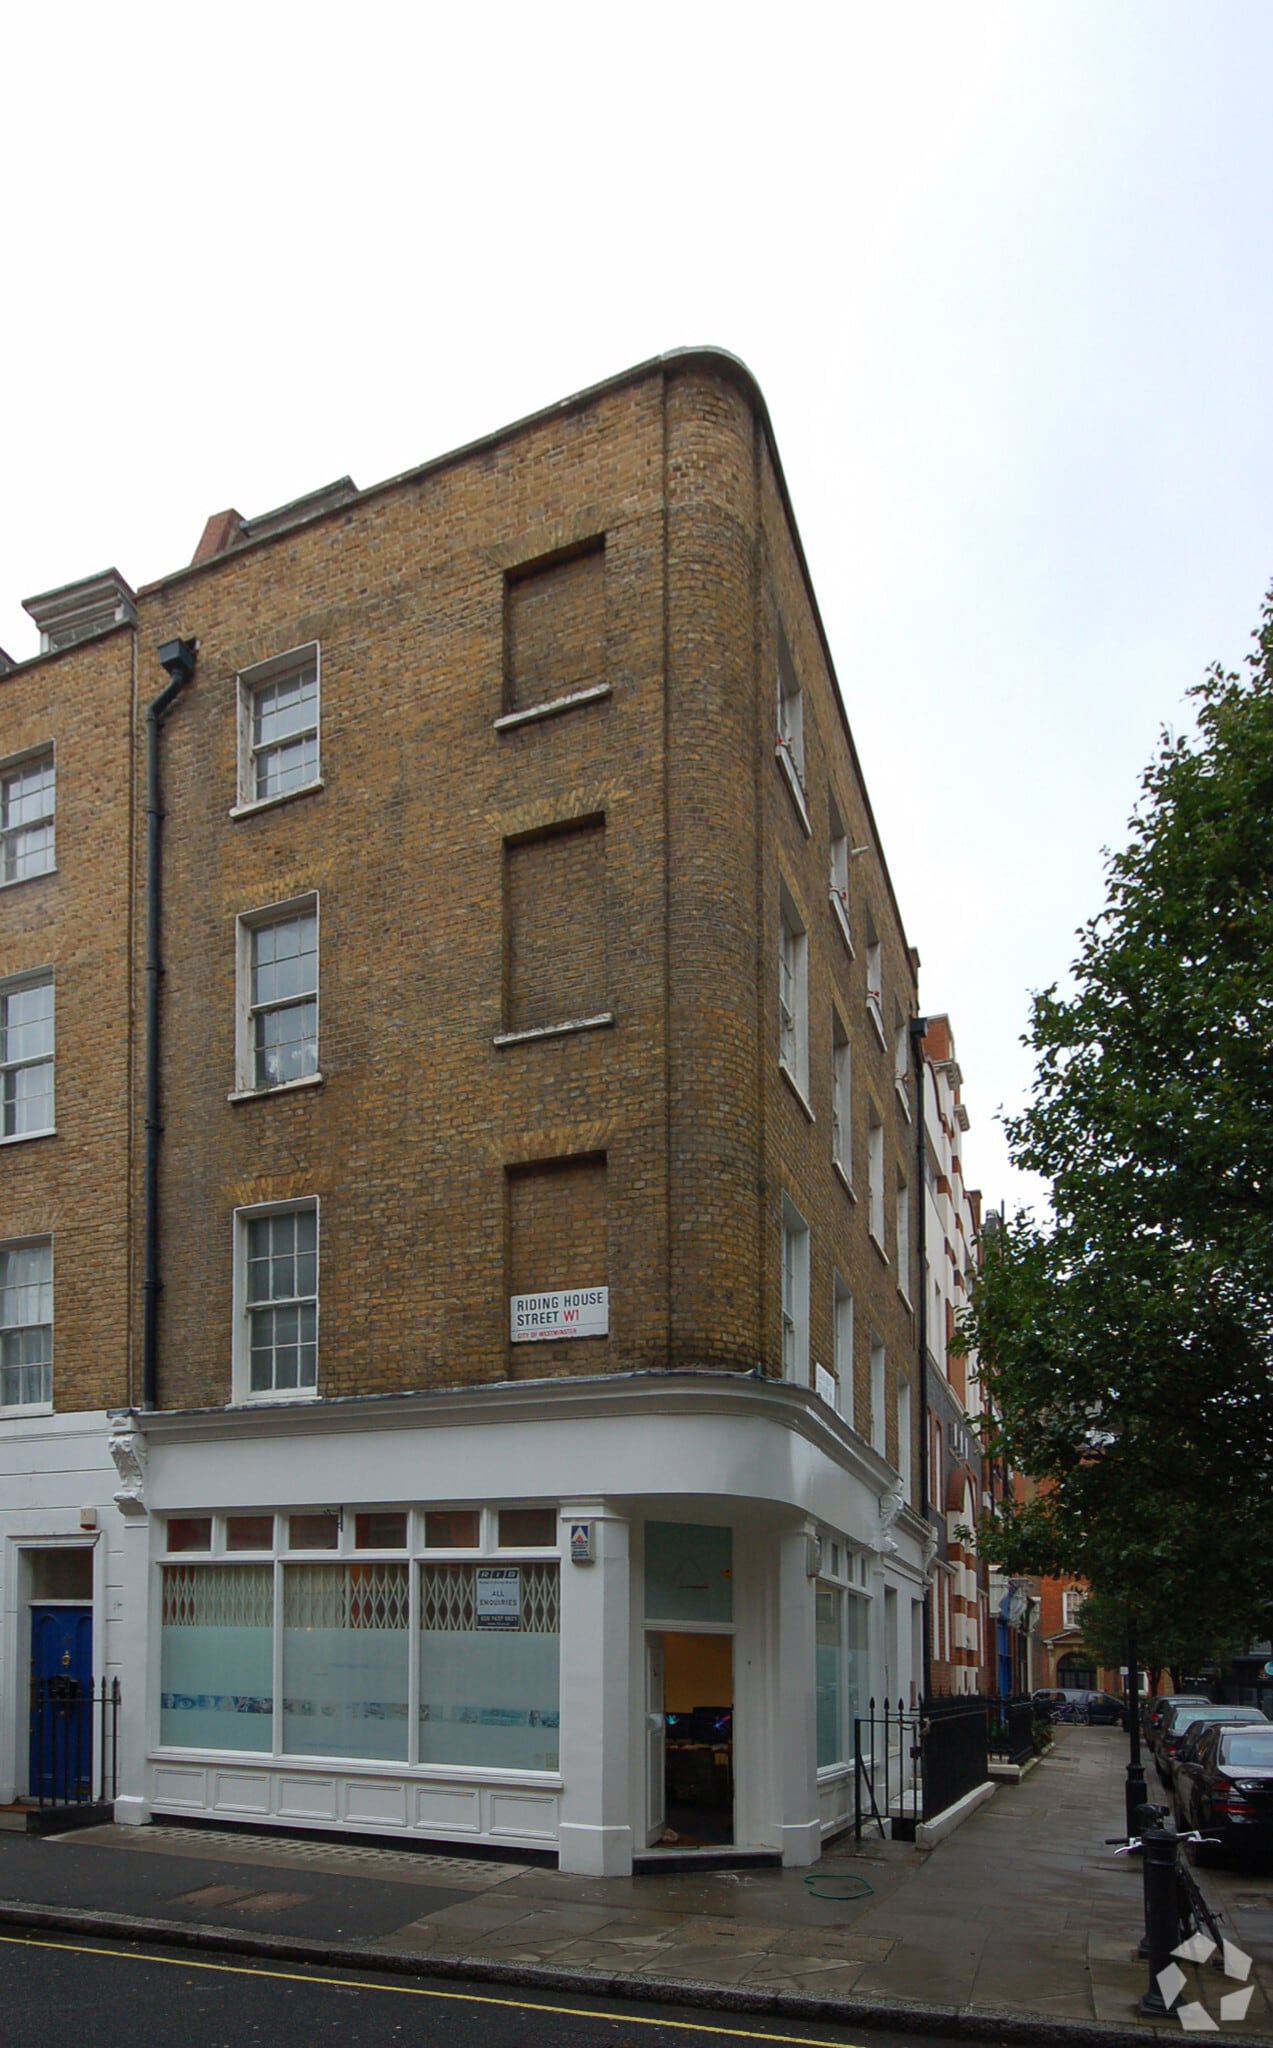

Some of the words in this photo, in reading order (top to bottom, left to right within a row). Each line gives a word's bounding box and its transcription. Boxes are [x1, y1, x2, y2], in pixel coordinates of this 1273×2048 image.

[517, 1297, 559, 1312] RIDING
[564, 1292, 604, 1307] HOUSE
[517, 1311, 559, 1326] STREET
[563, 1309, 580, 1322] W1
